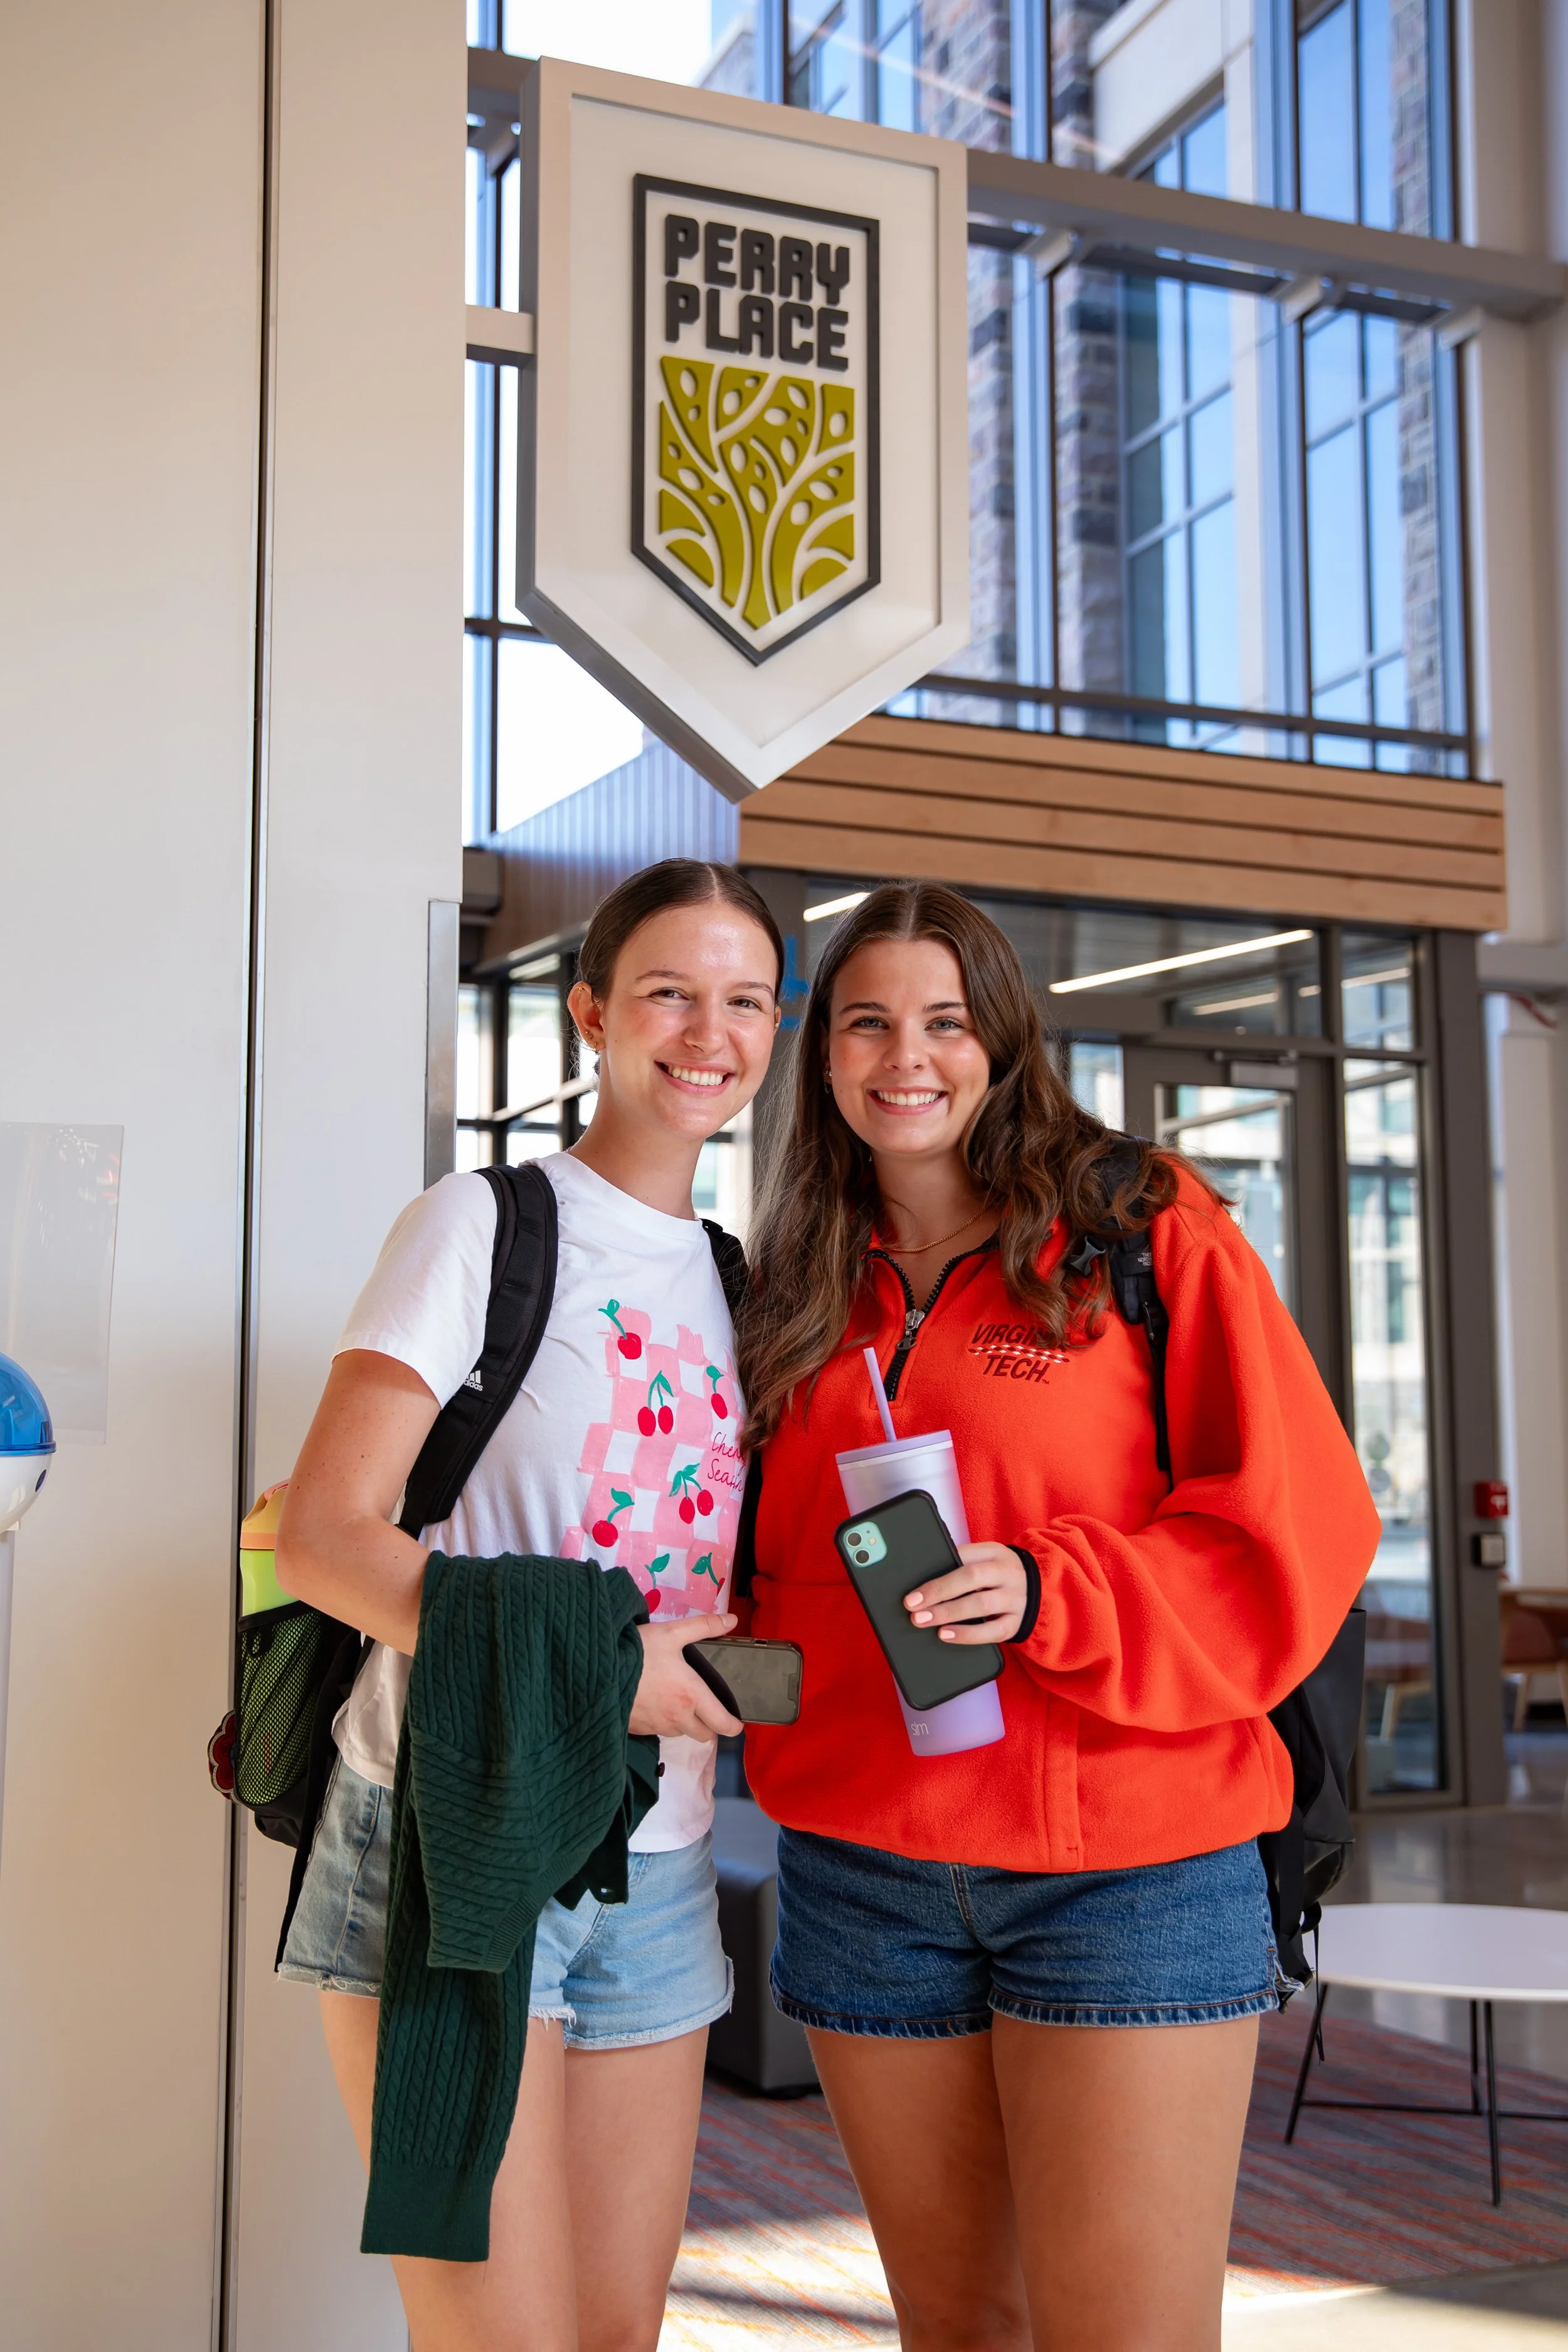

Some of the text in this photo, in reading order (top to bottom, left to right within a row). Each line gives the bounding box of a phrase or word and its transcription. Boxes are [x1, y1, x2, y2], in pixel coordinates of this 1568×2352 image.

[665, 214, 850, 306] PERRY
[665, 280, 849, 371] PLACE
[971, 1324, 1071, 1353] VIRGI
[983, 1354, 1051, 1382] TECH
